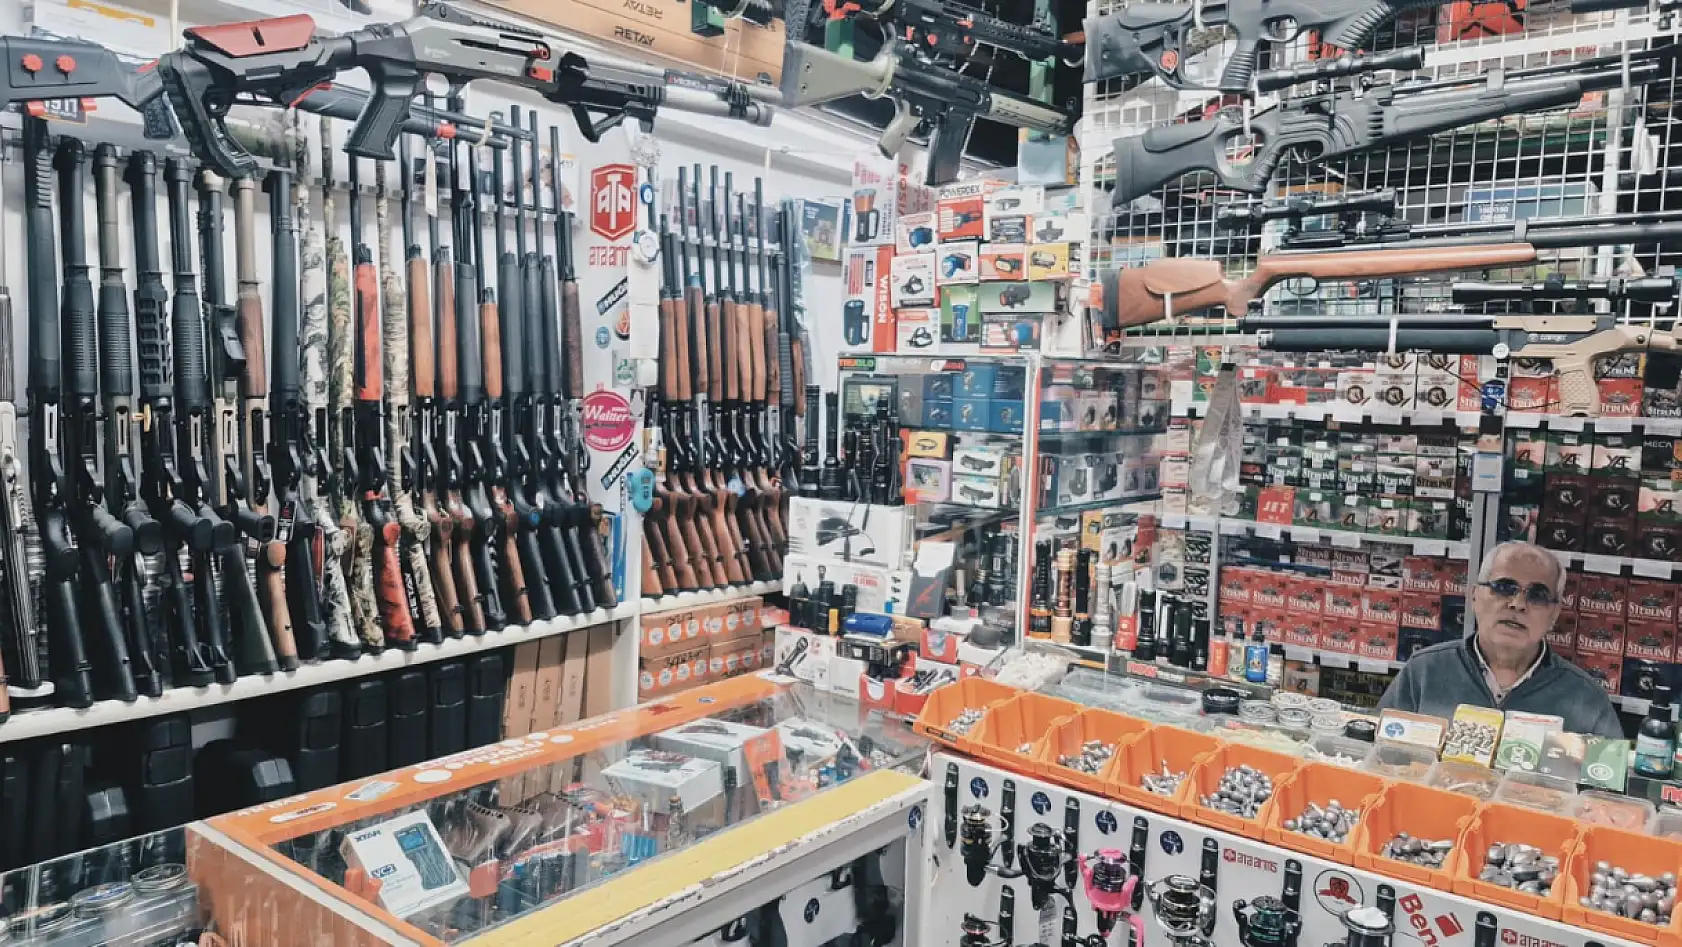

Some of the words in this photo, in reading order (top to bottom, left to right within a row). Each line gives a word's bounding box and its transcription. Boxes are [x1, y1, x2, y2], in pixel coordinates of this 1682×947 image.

[614, 26, 656, 46] RETAY
[939, 184, 981, 199] POWERDEX
[877, 273, 890, 324] WISON
[1262, 500, 1289, 513] JET
[1580, 596, 1622, 612] STERLING
[1629, 601, 1673, 618] STERLING
[1580, 635, 1620, 651] STERLING
[1628, 642, 1672, 658] STERLING
[354, 829, 382, 843] XTAR
